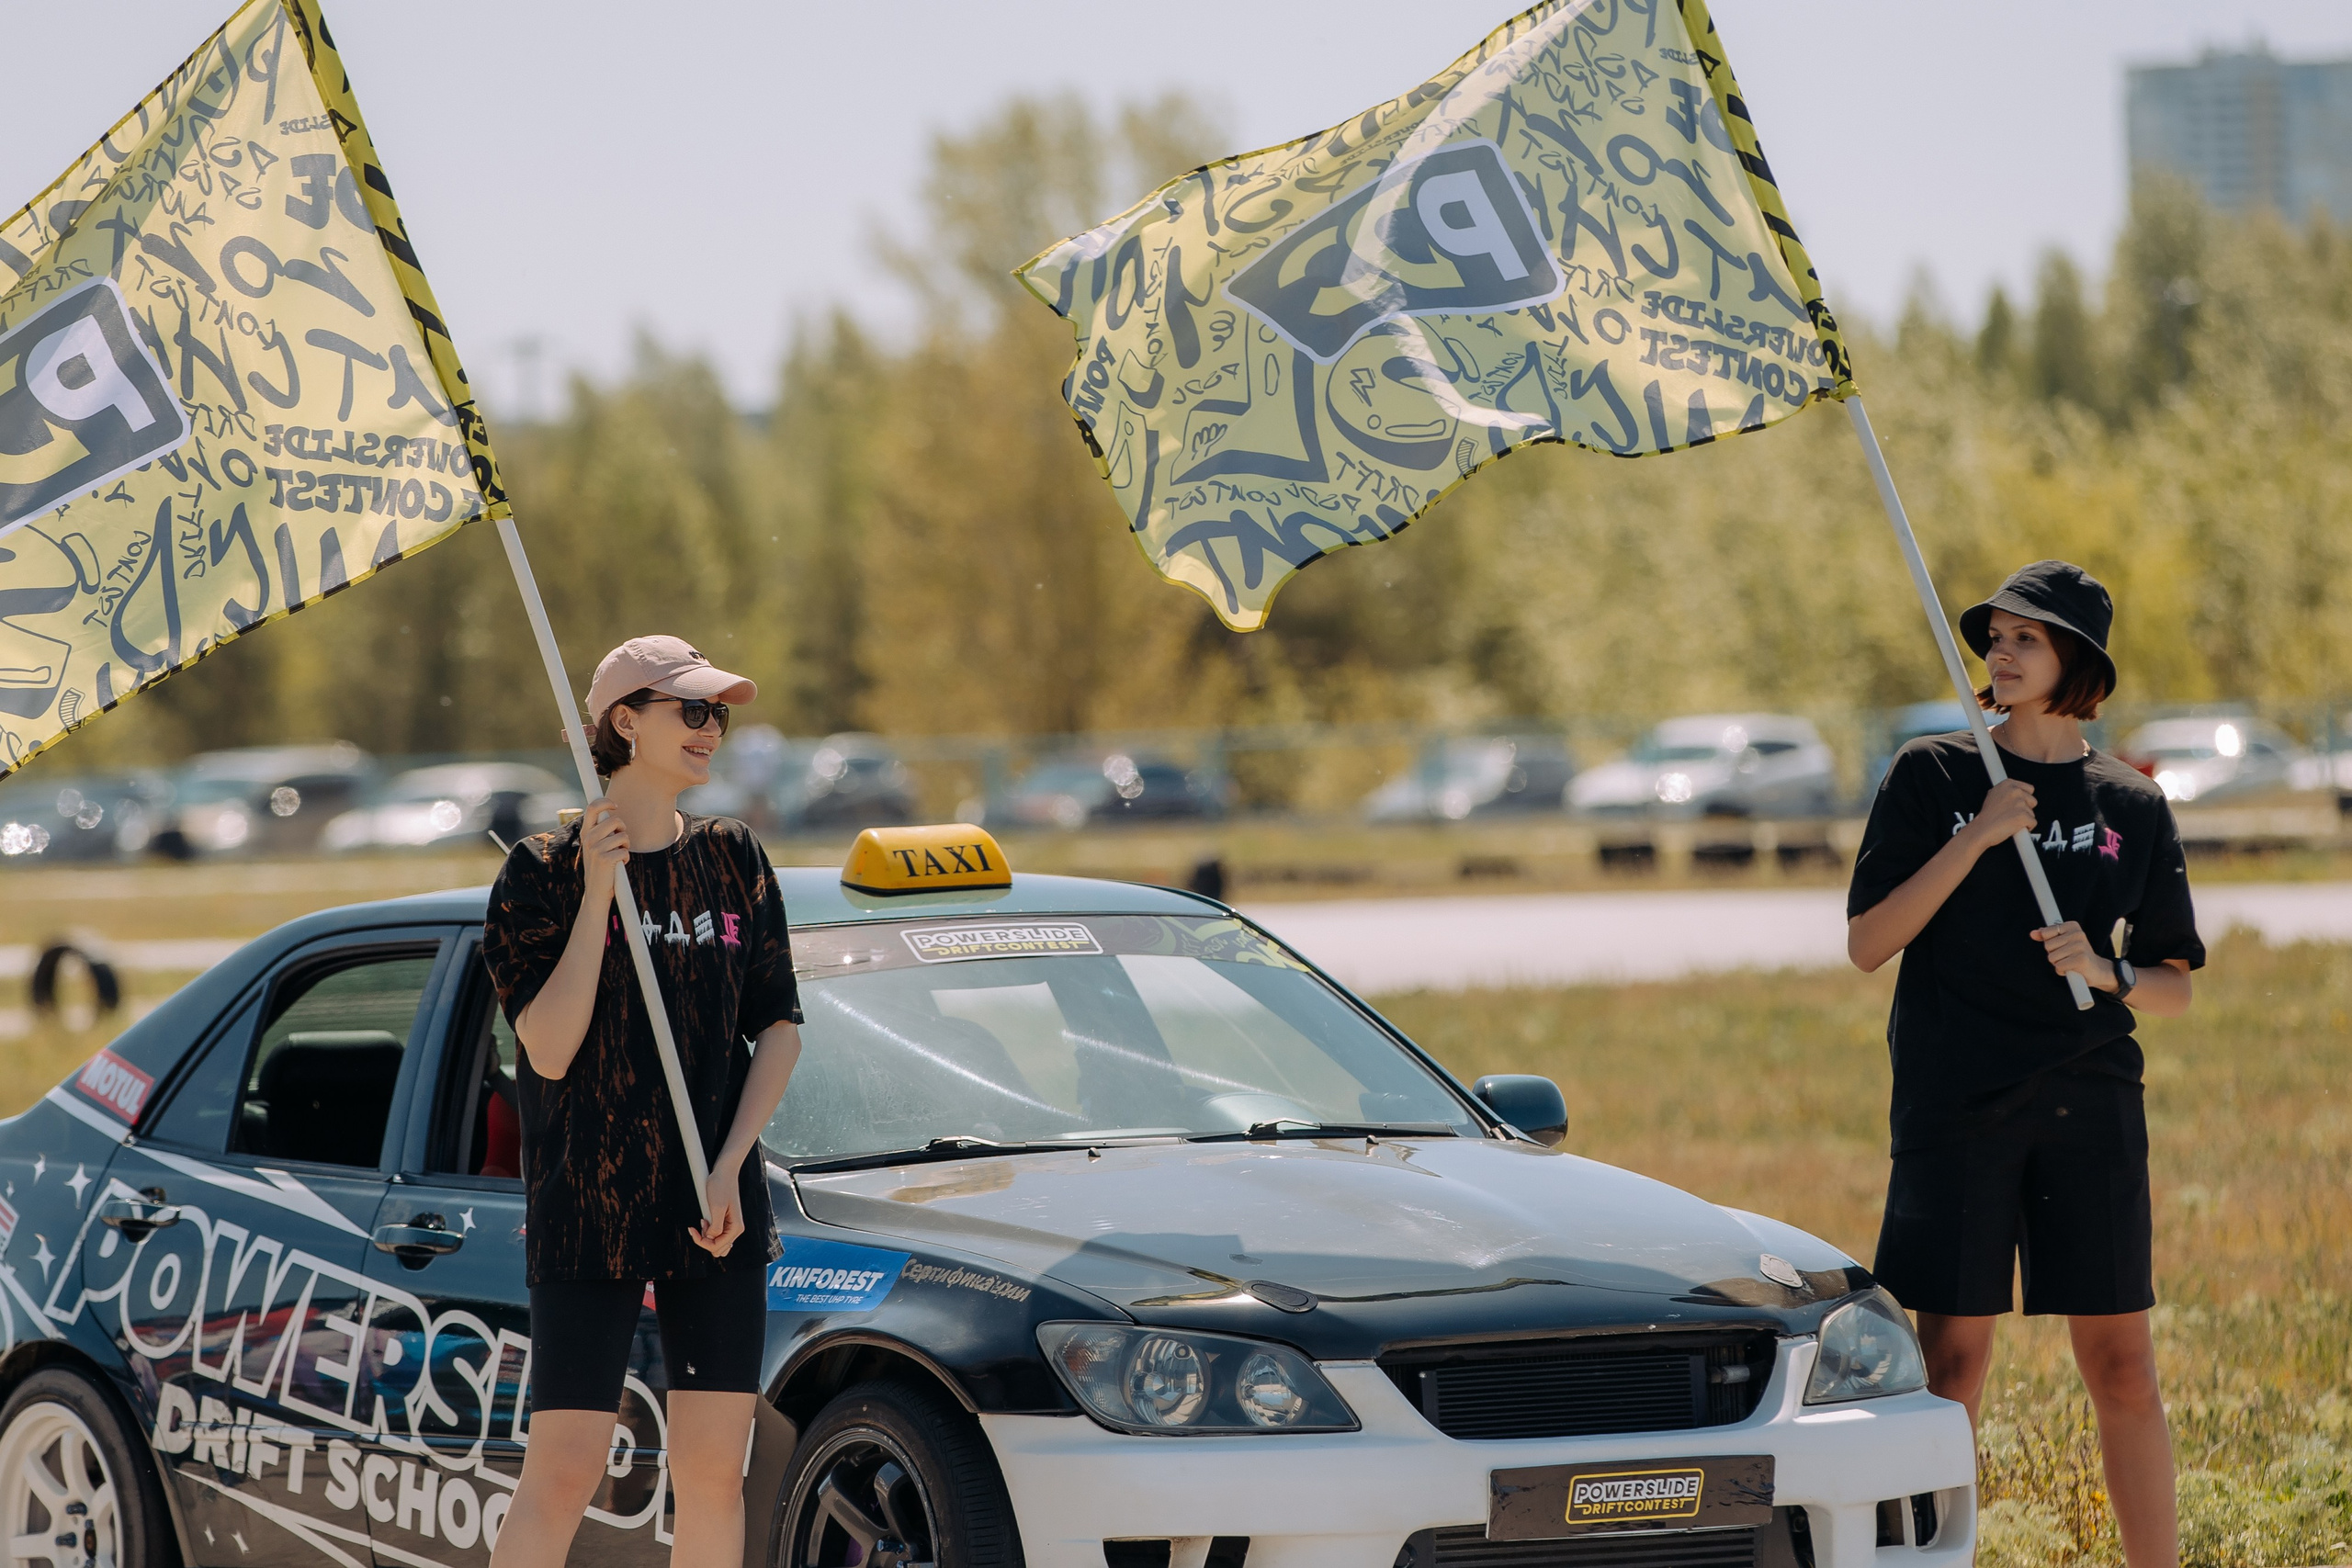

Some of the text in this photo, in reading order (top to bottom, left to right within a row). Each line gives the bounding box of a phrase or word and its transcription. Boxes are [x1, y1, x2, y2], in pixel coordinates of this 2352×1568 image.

[893, 843, 994, 878] TAXI
[911, 927, 1091, 950] POWERSLIDE
[81, 1054, 147, 1116] MOTUL
[769, 1267, 884, 1292] KINFOREST
[796, 1293, 864, 1304] THE BEST UHP TYRE
[152, 1382, 317, 1495] DRIFT
[1574, 1477, 1700, 1504] POWERSLIDE
[1574, 1497, 1695, 1516] DRIFTCONTEST
